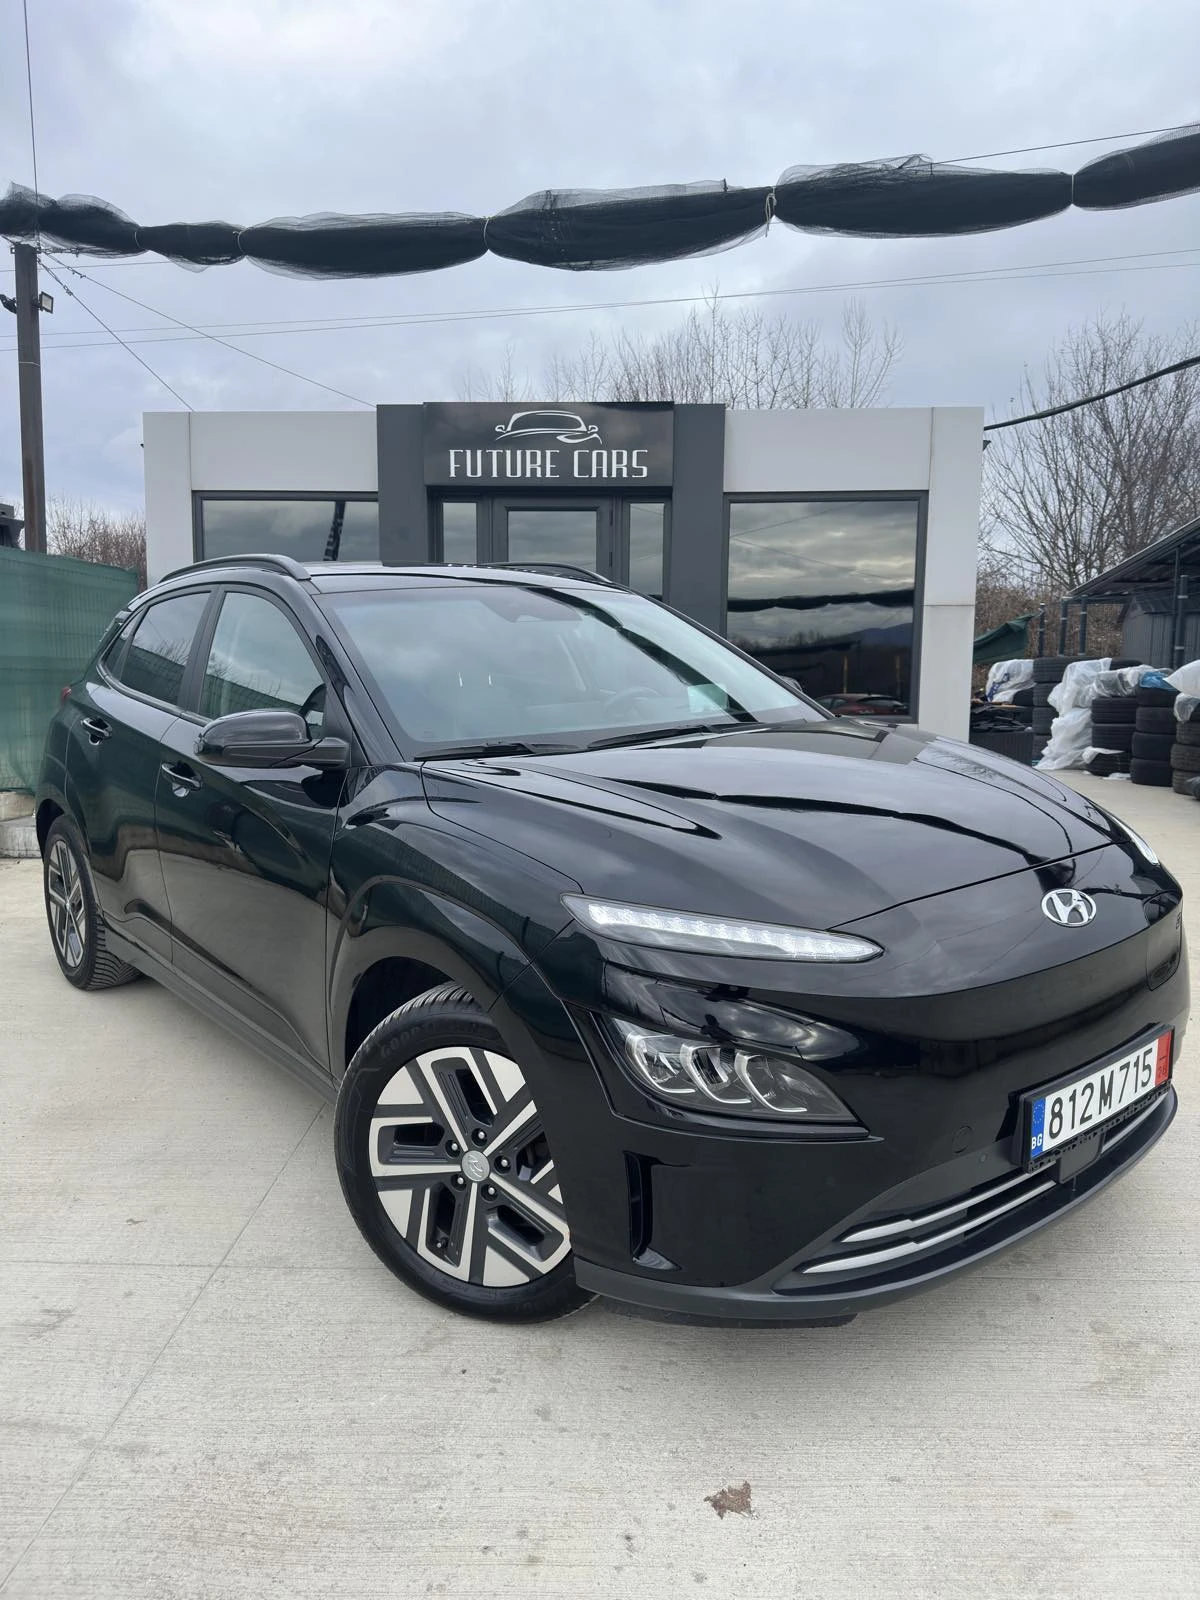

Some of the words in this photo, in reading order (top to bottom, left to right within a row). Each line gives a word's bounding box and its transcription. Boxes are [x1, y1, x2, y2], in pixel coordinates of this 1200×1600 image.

[449, 449, 559, 478] FUTURE
[573, 449, 648, 478] CARS
[1031, 1133, 1043, 1149] BG
